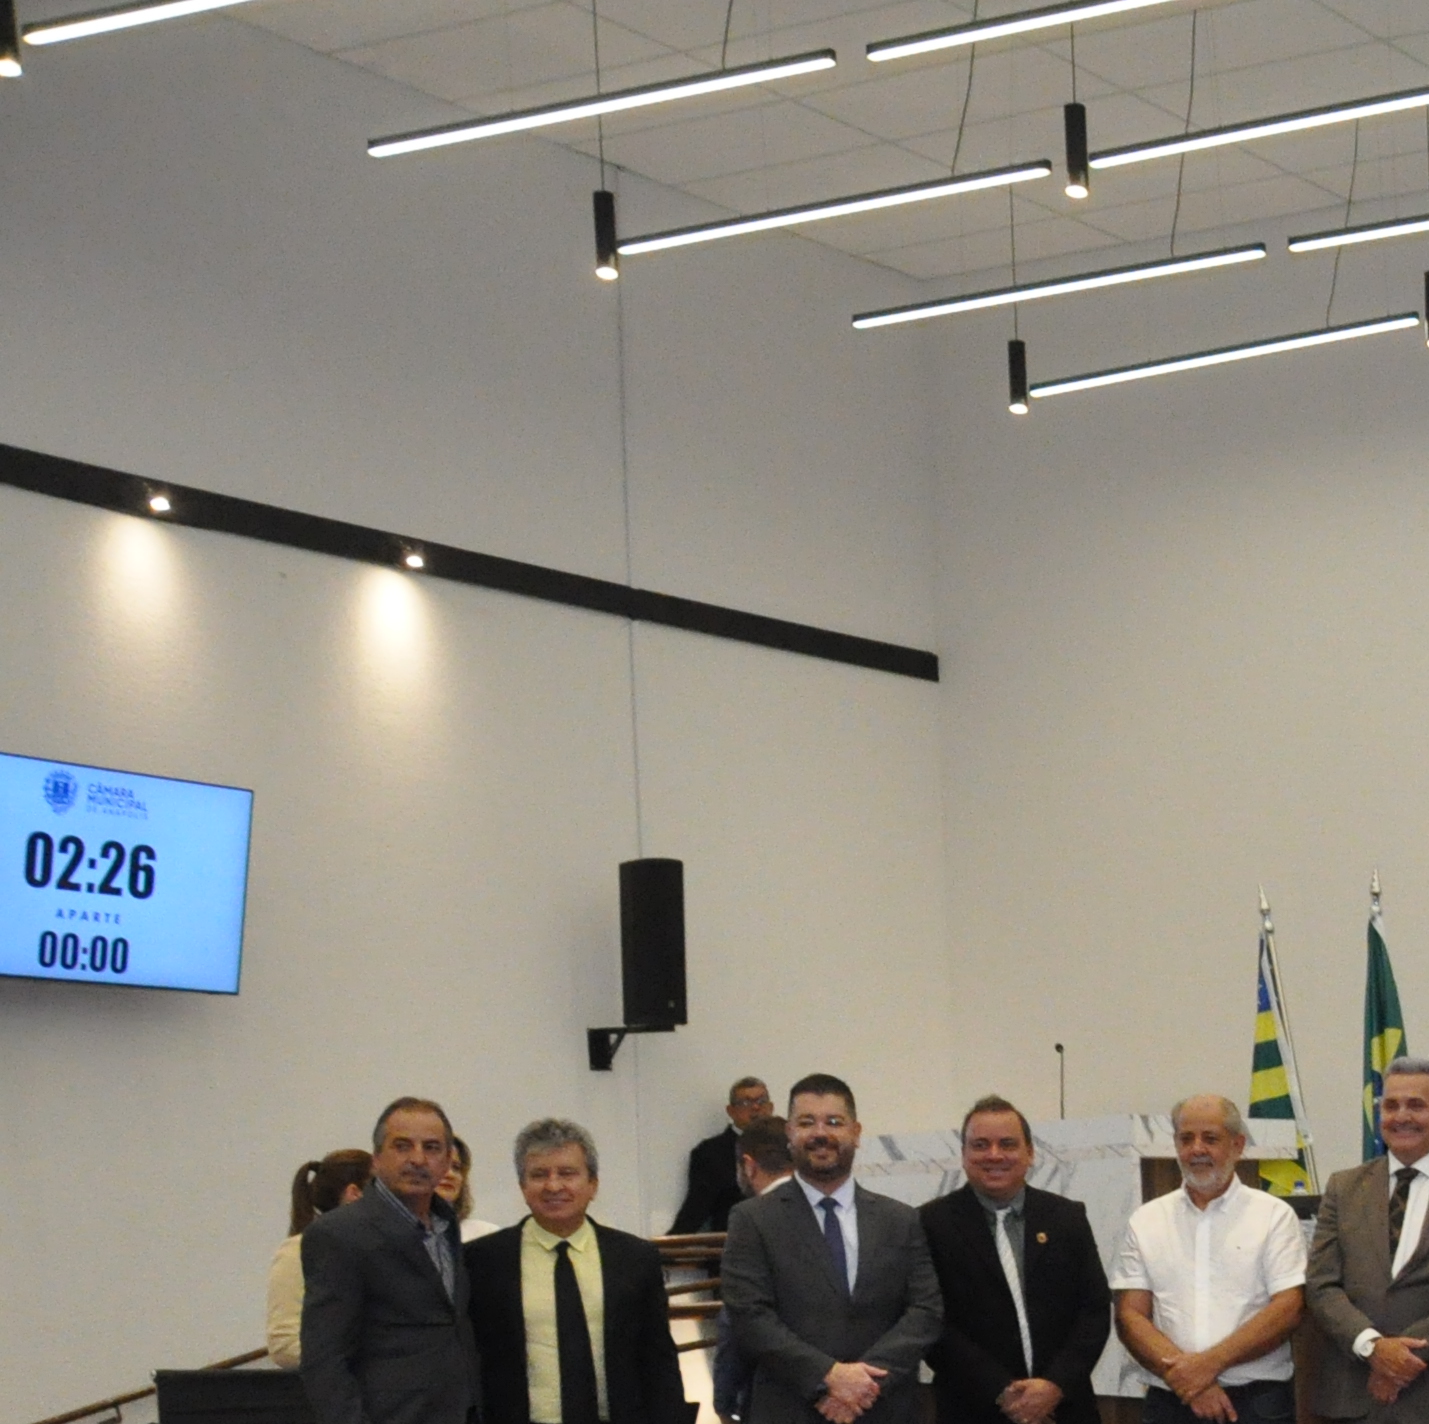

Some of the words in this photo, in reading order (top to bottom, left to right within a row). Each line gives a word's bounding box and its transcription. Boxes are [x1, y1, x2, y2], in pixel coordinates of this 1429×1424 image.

[25, 831, 156, 899] 02:26
[55, 908, 121, 924] APARTE
[38, 930, 129, 974] 00:00
